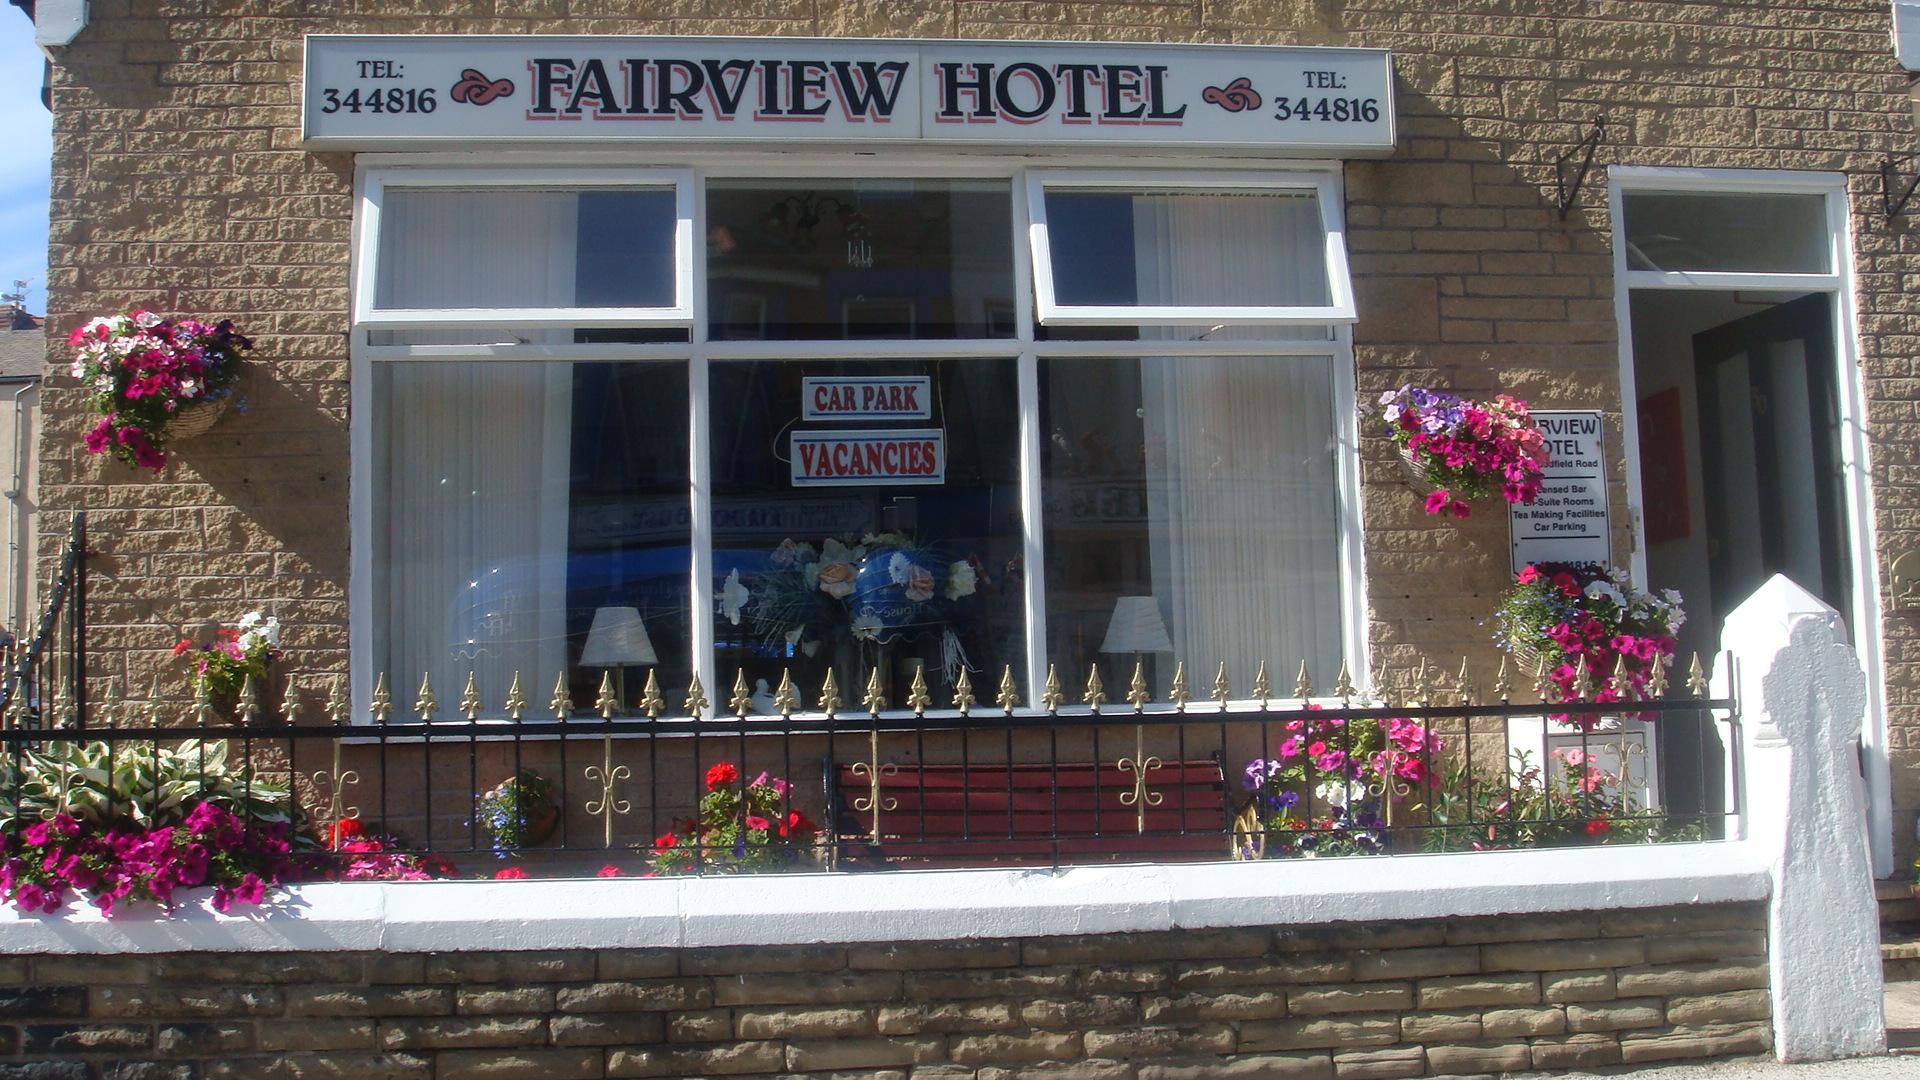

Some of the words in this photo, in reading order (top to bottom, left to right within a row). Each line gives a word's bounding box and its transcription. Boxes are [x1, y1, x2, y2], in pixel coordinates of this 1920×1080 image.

[356, 60, 404, 79] TEL:
[1303, 71, 1347, 89] TEL:
[527, 58, 909, 121] FAIRVIEW
[935, 62, 1187, 125] HOTEL
[321, 87, 437, 114] 344816
[1274, 97, 1379, 122] 344816
[815, 385, 857, 411] CAR
[862, 385, 919, 411] PARK
[1533, 419, 1596, 435] RVIEW
[1542, 440, 1584, 455] OTEL
[799, 441, 936, 476] VACANCIES
[1576, 459, 1598, 468] Road
[1537, 485, 1569, 494] censed
[1571, 485, 1587, 493] Bar
[1563, 497, 1594, 505] Rooms
[1513, 511, 1529, 519] Tea
[1531, 510, 1563, 520] Making
[1566, 509, 1605, 518] Facilities
[1534, 522, 1550, 532] Car
[1552, 522, 1587, 532] Parking
